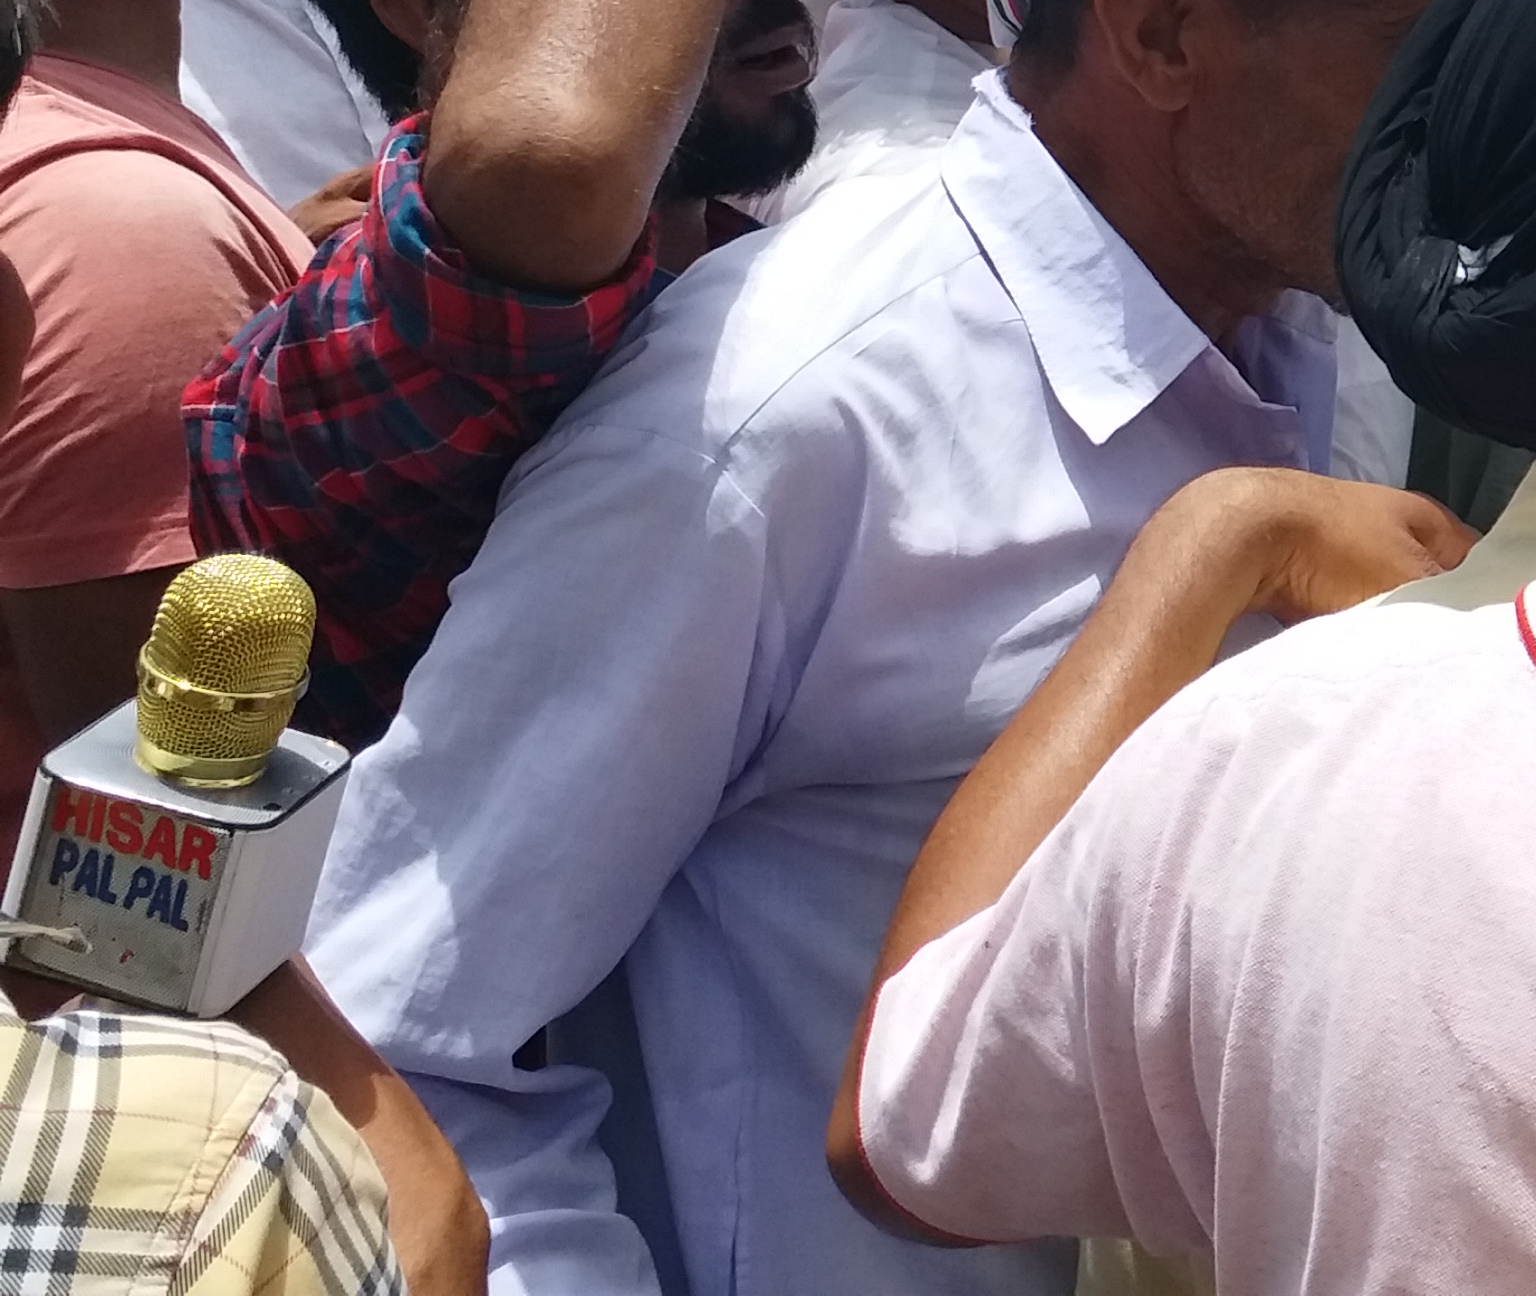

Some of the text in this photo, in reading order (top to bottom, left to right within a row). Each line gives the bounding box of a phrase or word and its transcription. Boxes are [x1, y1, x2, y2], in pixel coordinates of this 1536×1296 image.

[51, 785, 218, 882] HISAR
[48, 836, 189, 934] PAL PAL
